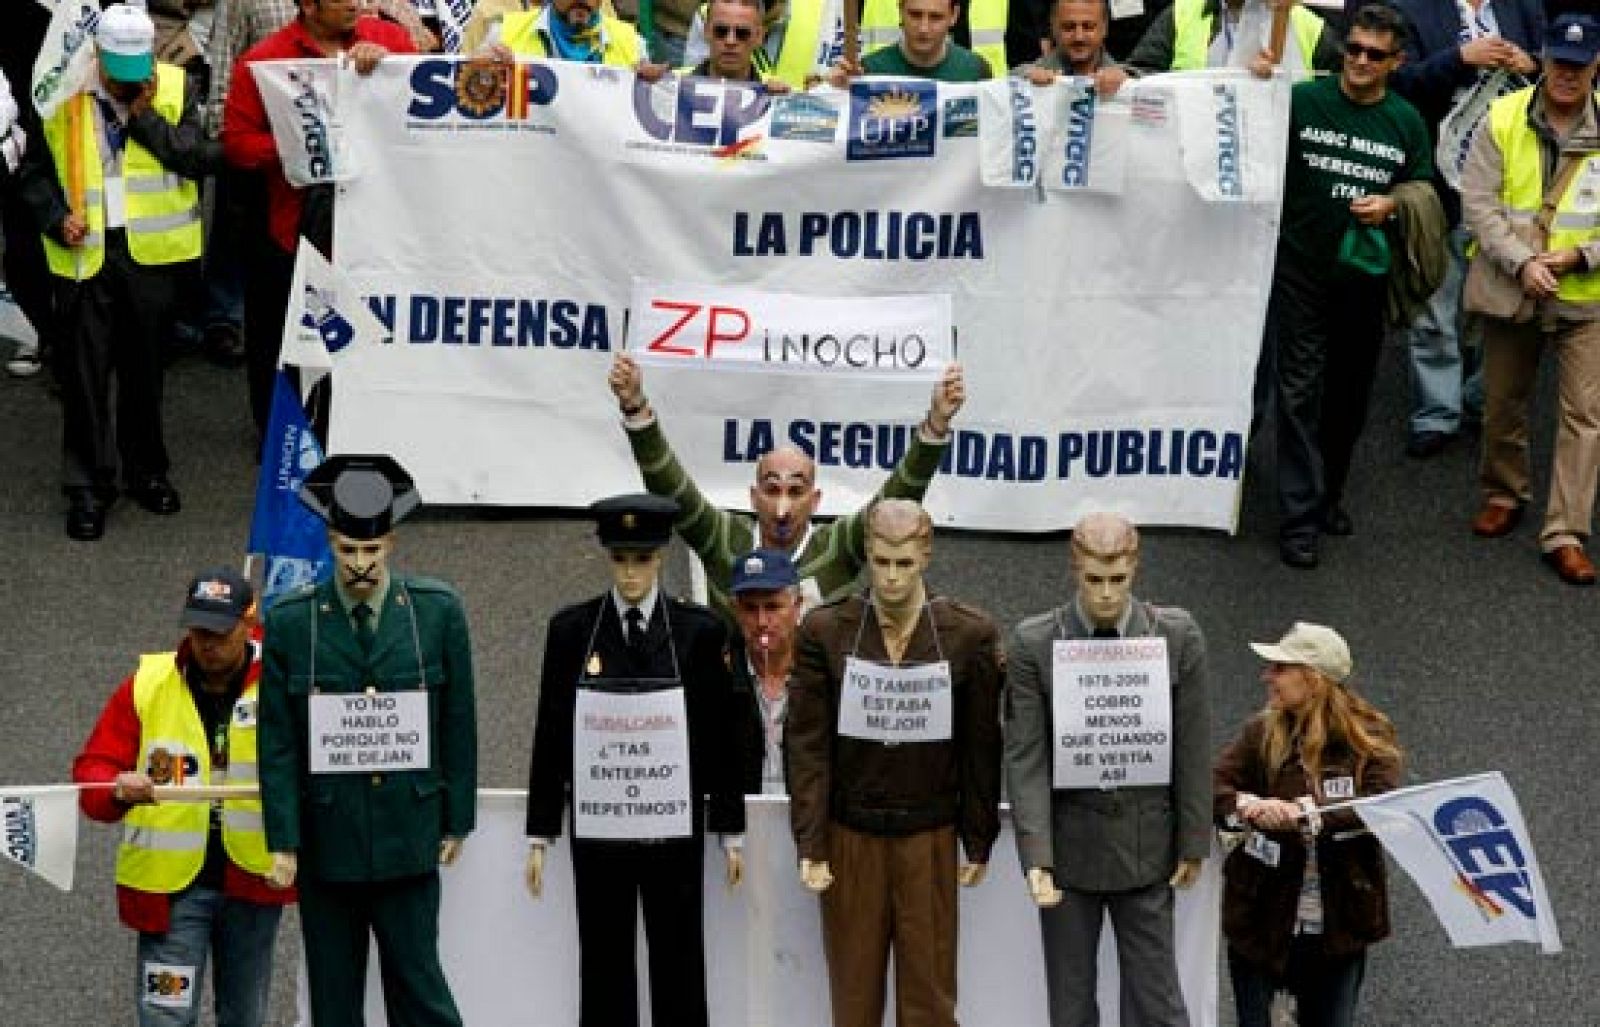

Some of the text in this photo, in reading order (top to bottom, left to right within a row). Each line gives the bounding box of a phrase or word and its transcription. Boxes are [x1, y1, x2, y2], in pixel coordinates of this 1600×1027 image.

[632, 75, 771, 147] CEP
[860, 115, 930, 144] UFP
[1299, 125, 1348, 148] AUGC
[732, 211, 984, 260] LA POLICIA
[408, 295, 611, 351] DEFENSA
[723, 418, 1244, 483] LA SEGUIDAD PUBLICA
[849, 672, 871, 690] YO
[342, 697, 397, 711] YO NO
[863, 694, 932, 711] ESTABA
[1084, 694, 1143, 710] COBRO
[340, 713, 400, 729] HABLO
[866, 714, 929, 731] MEJOR
[1084, 713, 1143, 728] MENOS
[322, 730, 420, 749] PORQUE NO
[1061, 731, 1167, 748] QUE CUANDO
[328, 748, 414, 766] ME DEJAN
[1073, 752, 1095, 767] SE
[625, 784, 641, 798] O
[579, 800, 687, 816] REPETIMOS?
[1433, 796, 1537, 920] CEP
